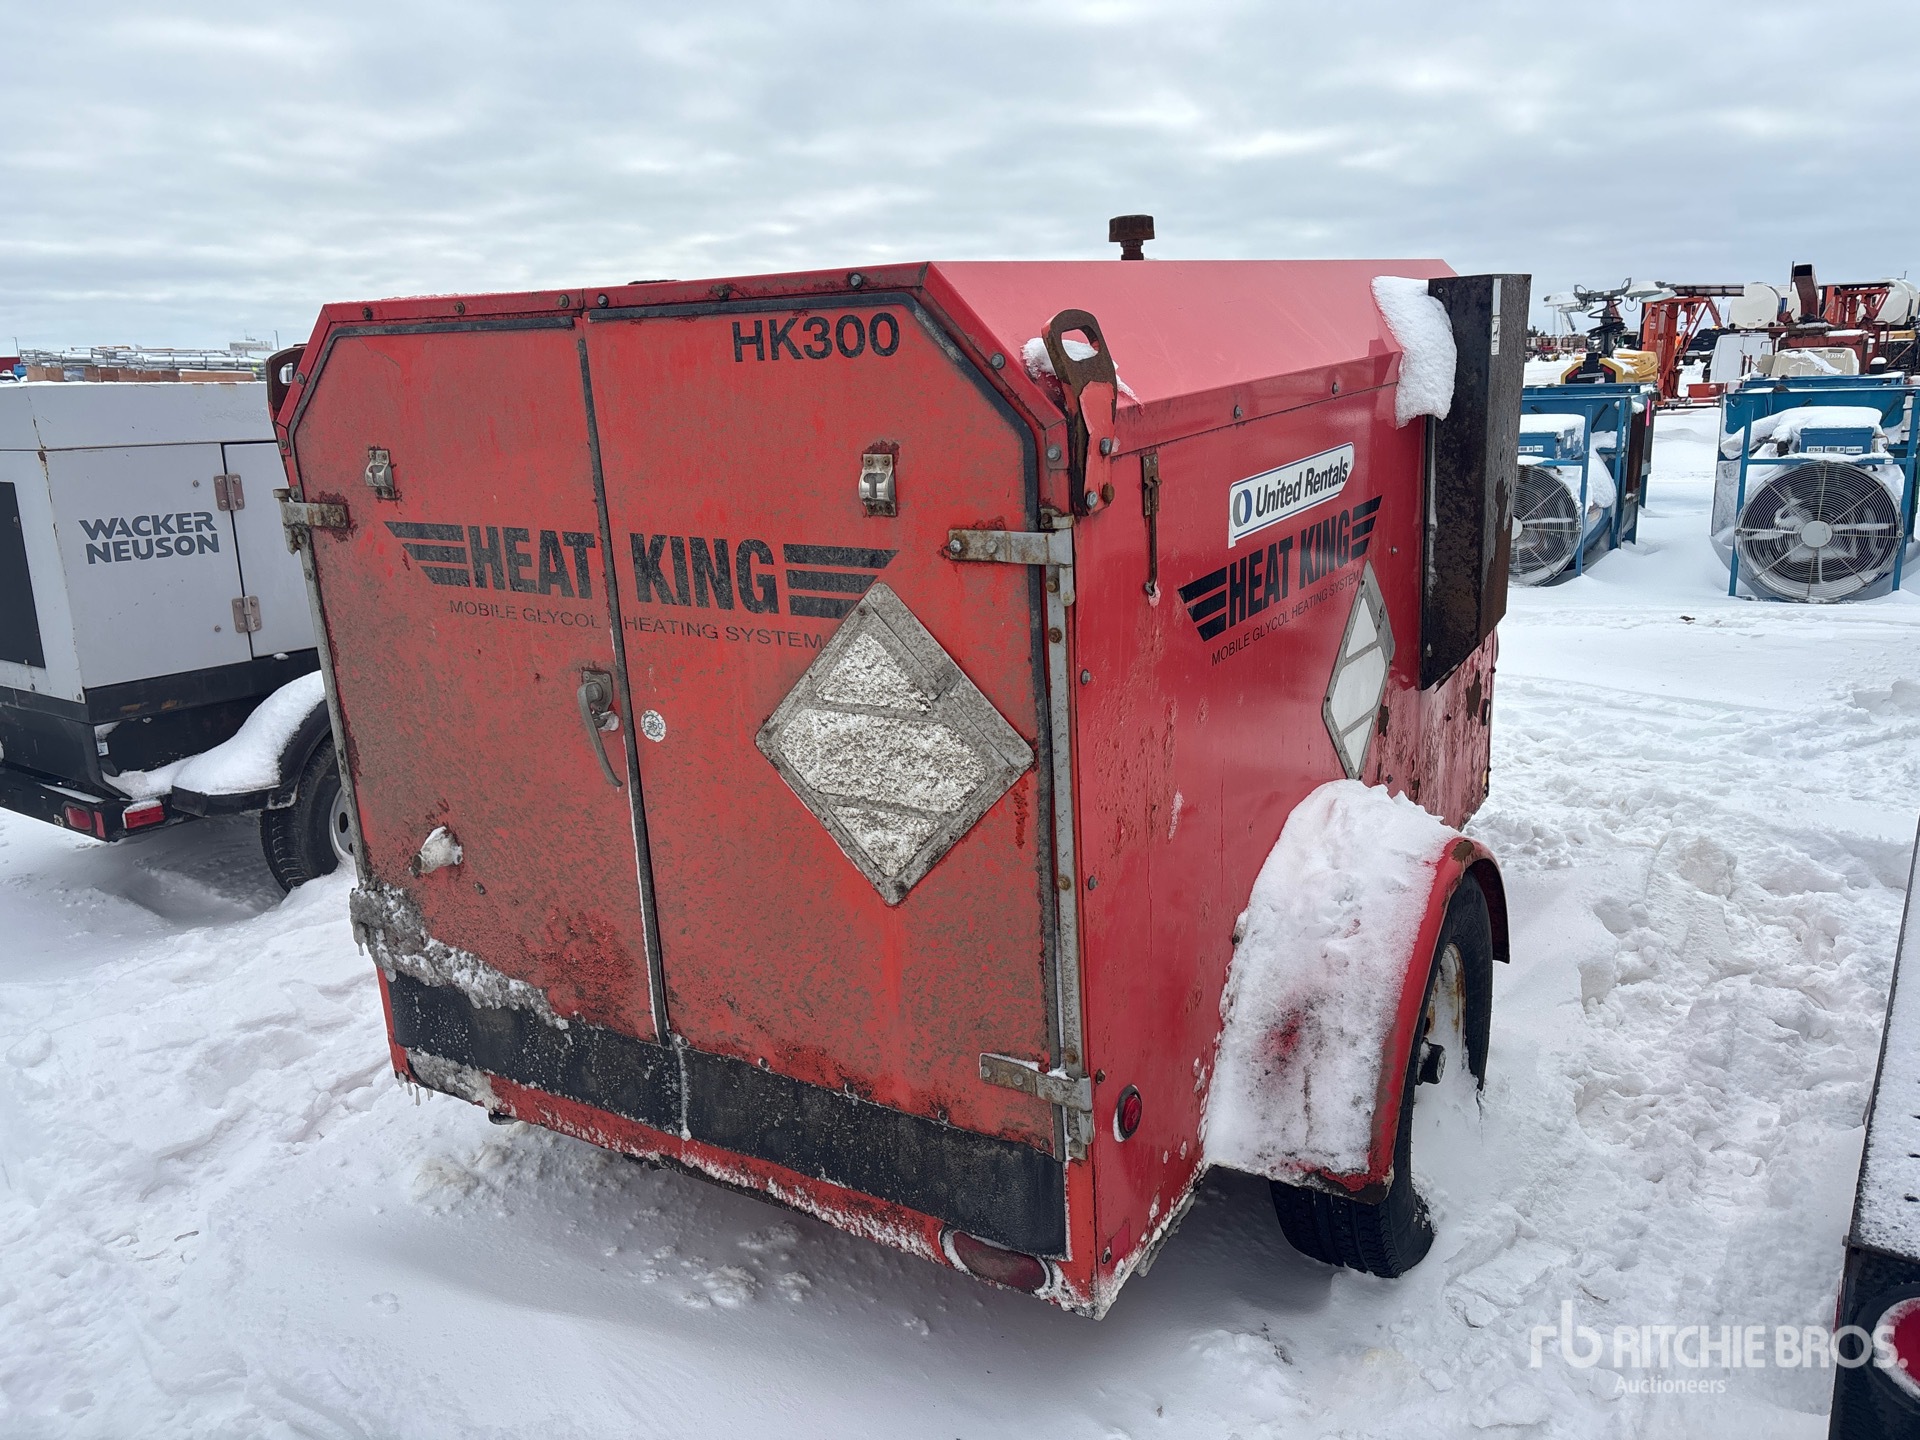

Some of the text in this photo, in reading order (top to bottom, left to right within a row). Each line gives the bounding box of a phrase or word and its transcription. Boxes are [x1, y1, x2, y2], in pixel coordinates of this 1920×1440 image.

[732, 312, 900, 362] HK300
[1255, 455, 1349, 518] United Rentals
[78, 511, 218, 541] WACKER
[85, 533, 220, 565] NEUSON
[467, 525, 780, 615] HEAT KING
[1228, 509, 1350, 629] HEAT KING
[449, 599, 518, 621] MOBILE
[521, 606, 601, 629] GLYCOL
[624, 614, 719, 640] HEATING
[1211, 632, 1251, 667] MOBILE
[1252, 613, 1290, 641] GLYCOL
[1291, 593, 1328, 621] HEATING
